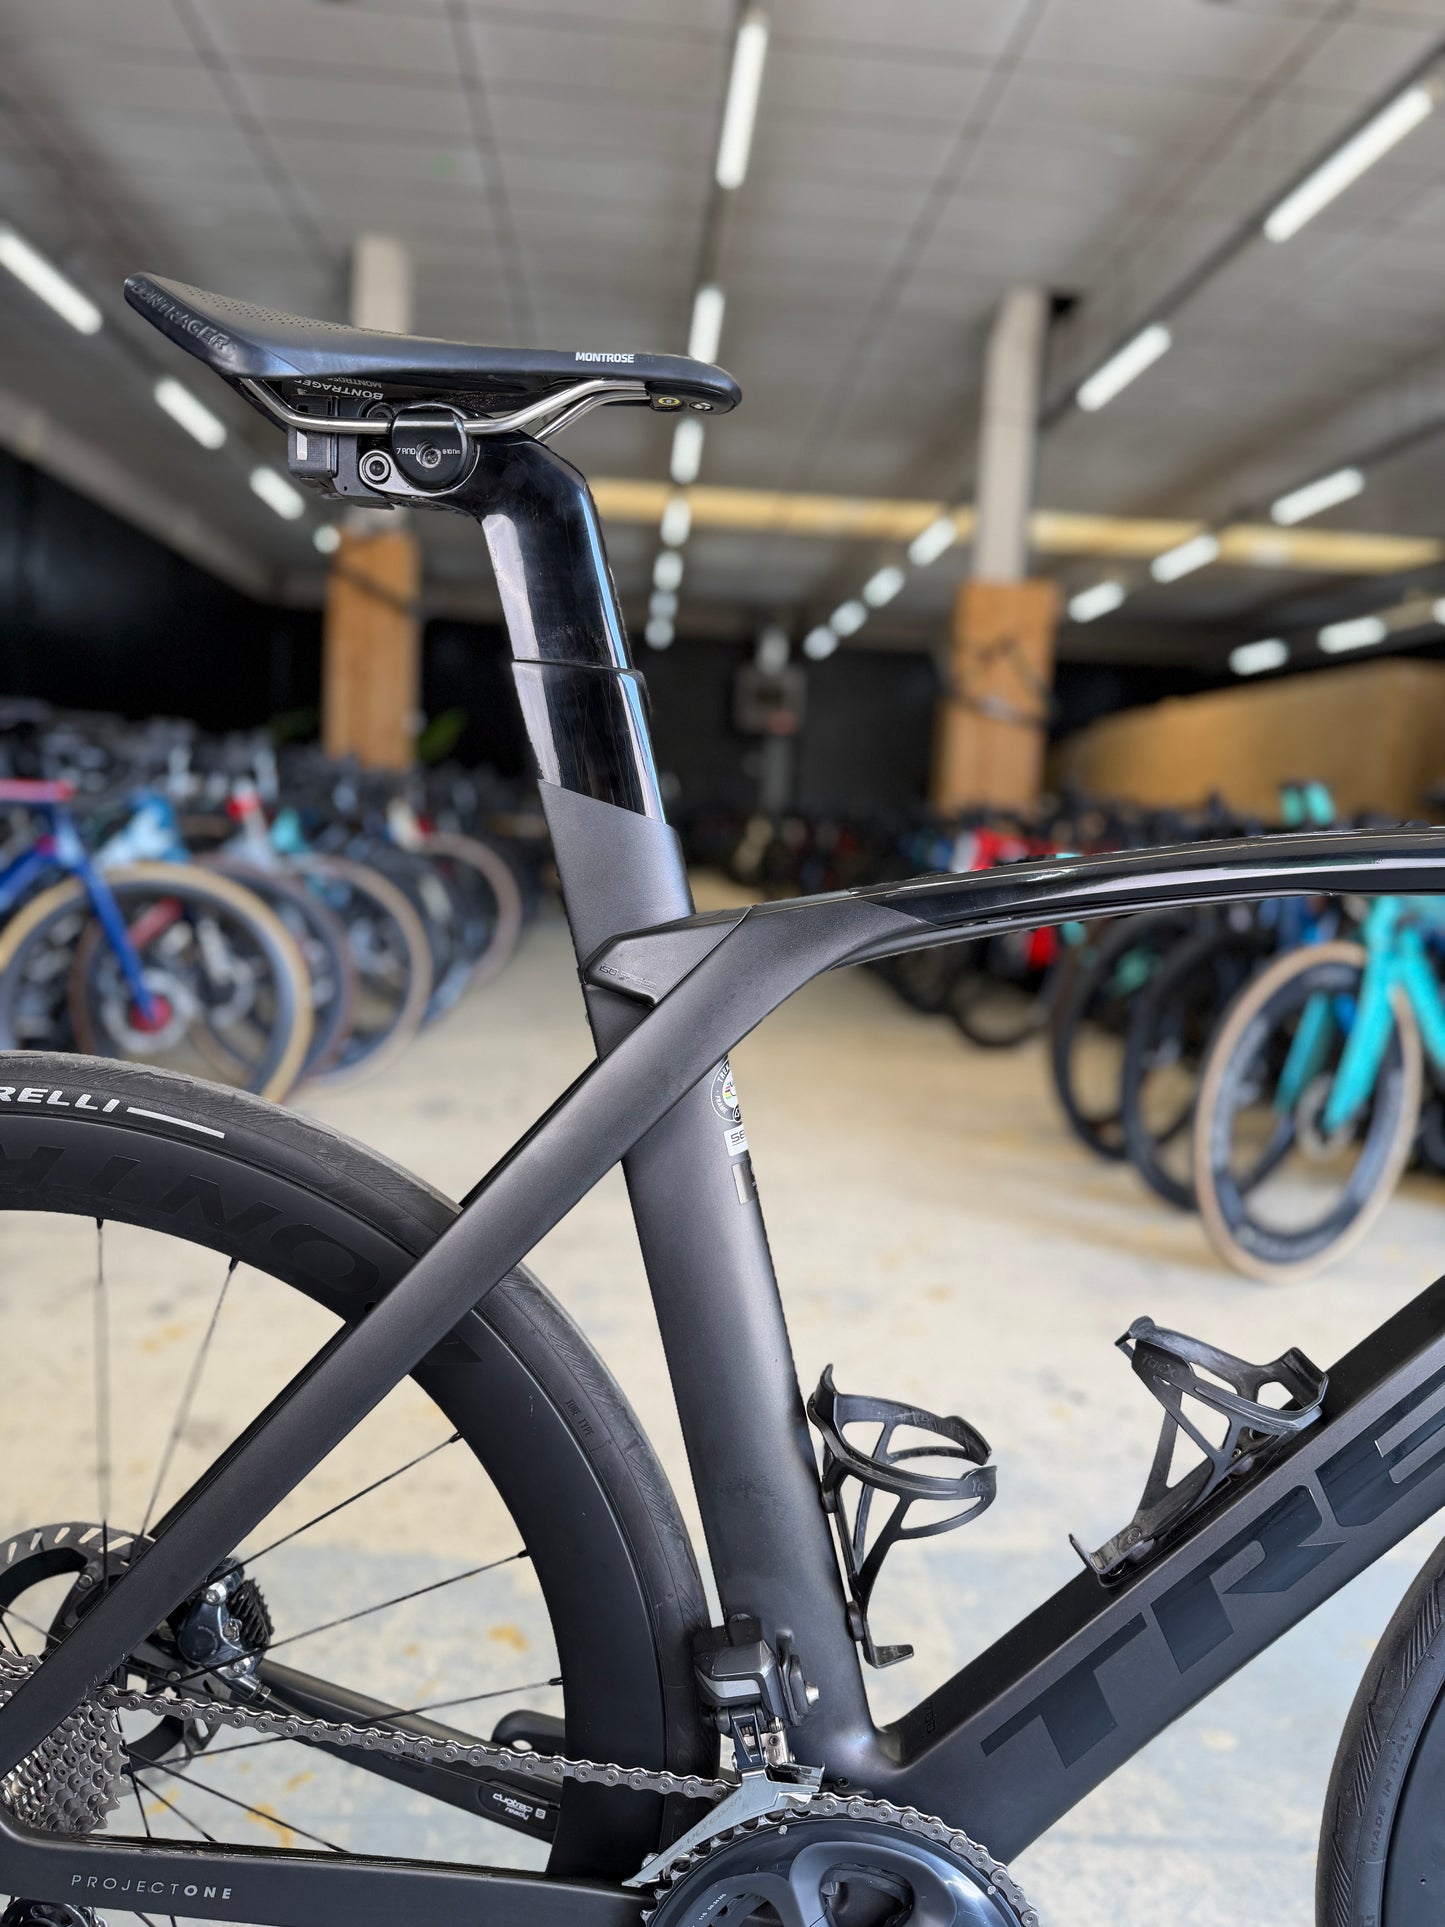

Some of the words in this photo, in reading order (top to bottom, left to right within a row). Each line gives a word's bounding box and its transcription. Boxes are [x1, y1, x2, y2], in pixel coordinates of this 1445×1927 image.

[130, 280, 231, 350] BONTRAGER
[575, 351, 634, 363] MONTROSE
[714, 1095, 728, 1114] FRAME
[566, 1398, 582, 1416] TUBE
[578, 1418, 595, 1438] TYPE
[1370, 1805, 1387, 1855] MADE
[1381, 1779, 1394, 1797] IN
[1391, 1716, 1414, 1774] ITALY
[504, 1807, 530, 1820] ready
